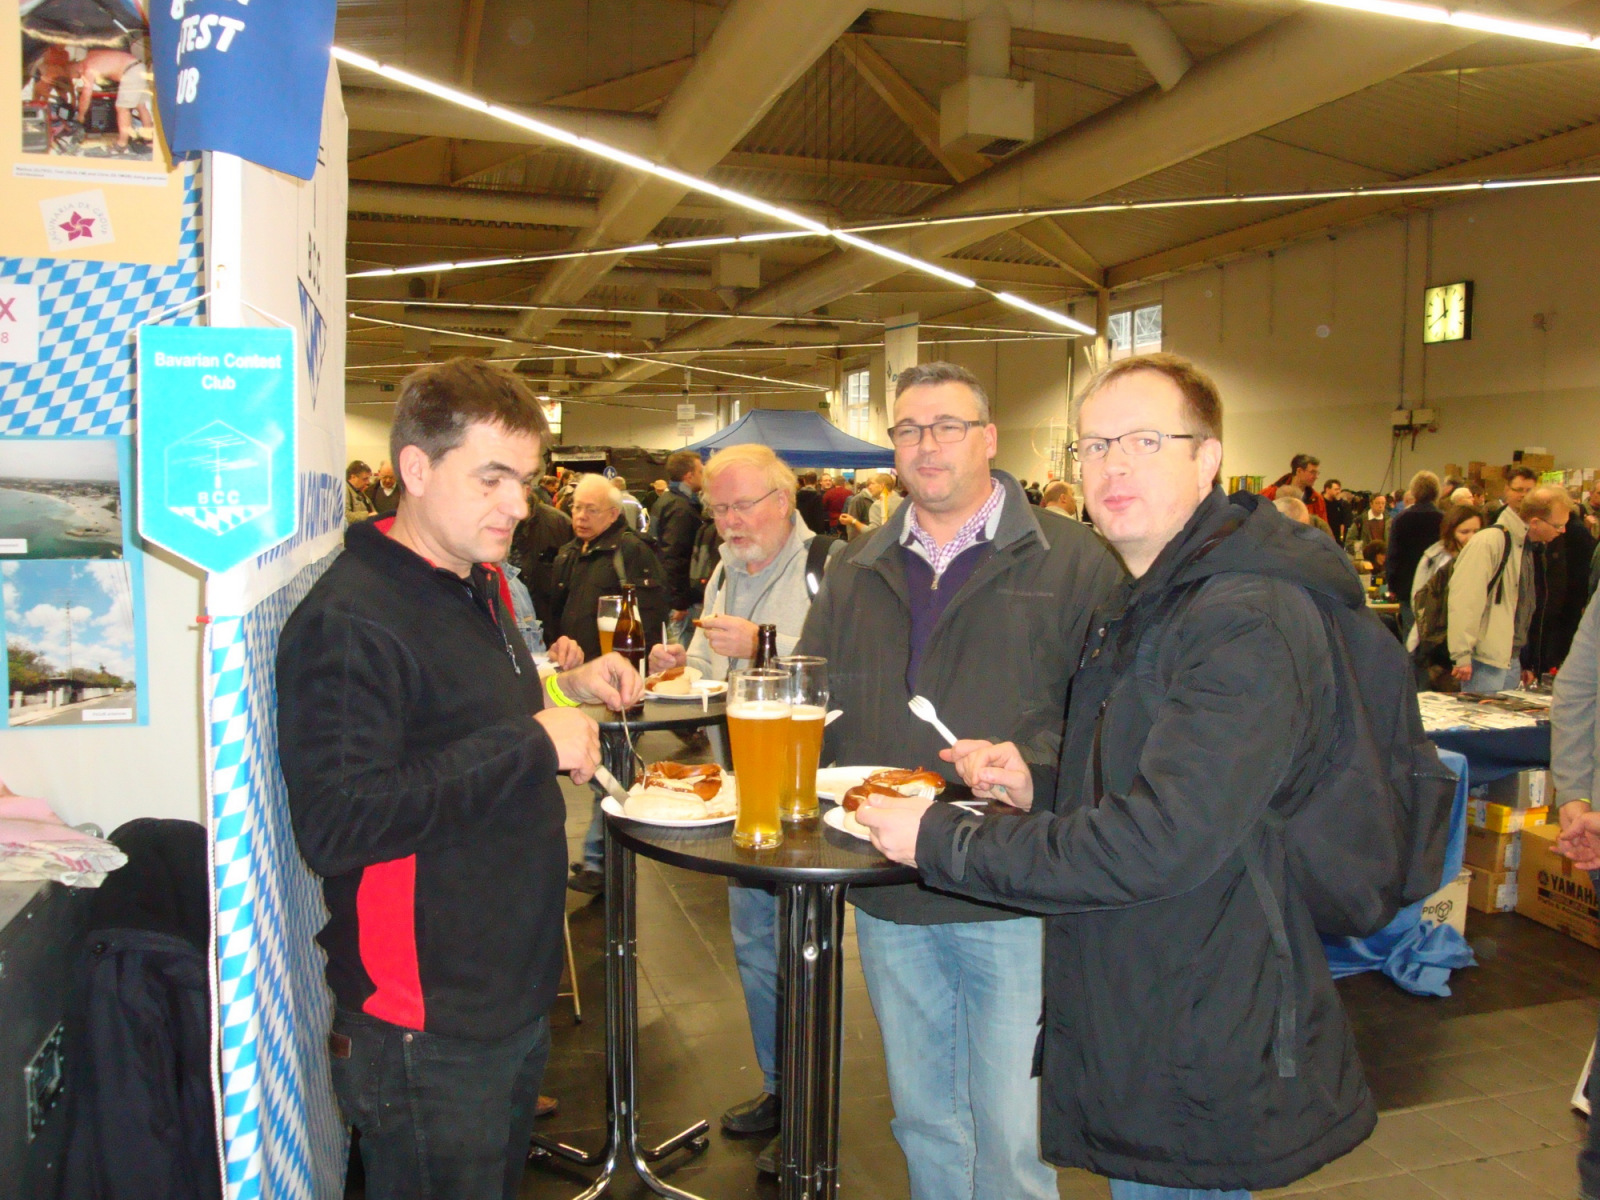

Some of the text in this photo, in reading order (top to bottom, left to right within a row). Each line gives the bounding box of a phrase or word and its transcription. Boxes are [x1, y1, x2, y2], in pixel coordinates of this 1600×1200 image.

[154, 352, 281, 369] Bavarian Contest
[201, 374, 236, 389] Club
[198, 490, 240, 504] BCC
